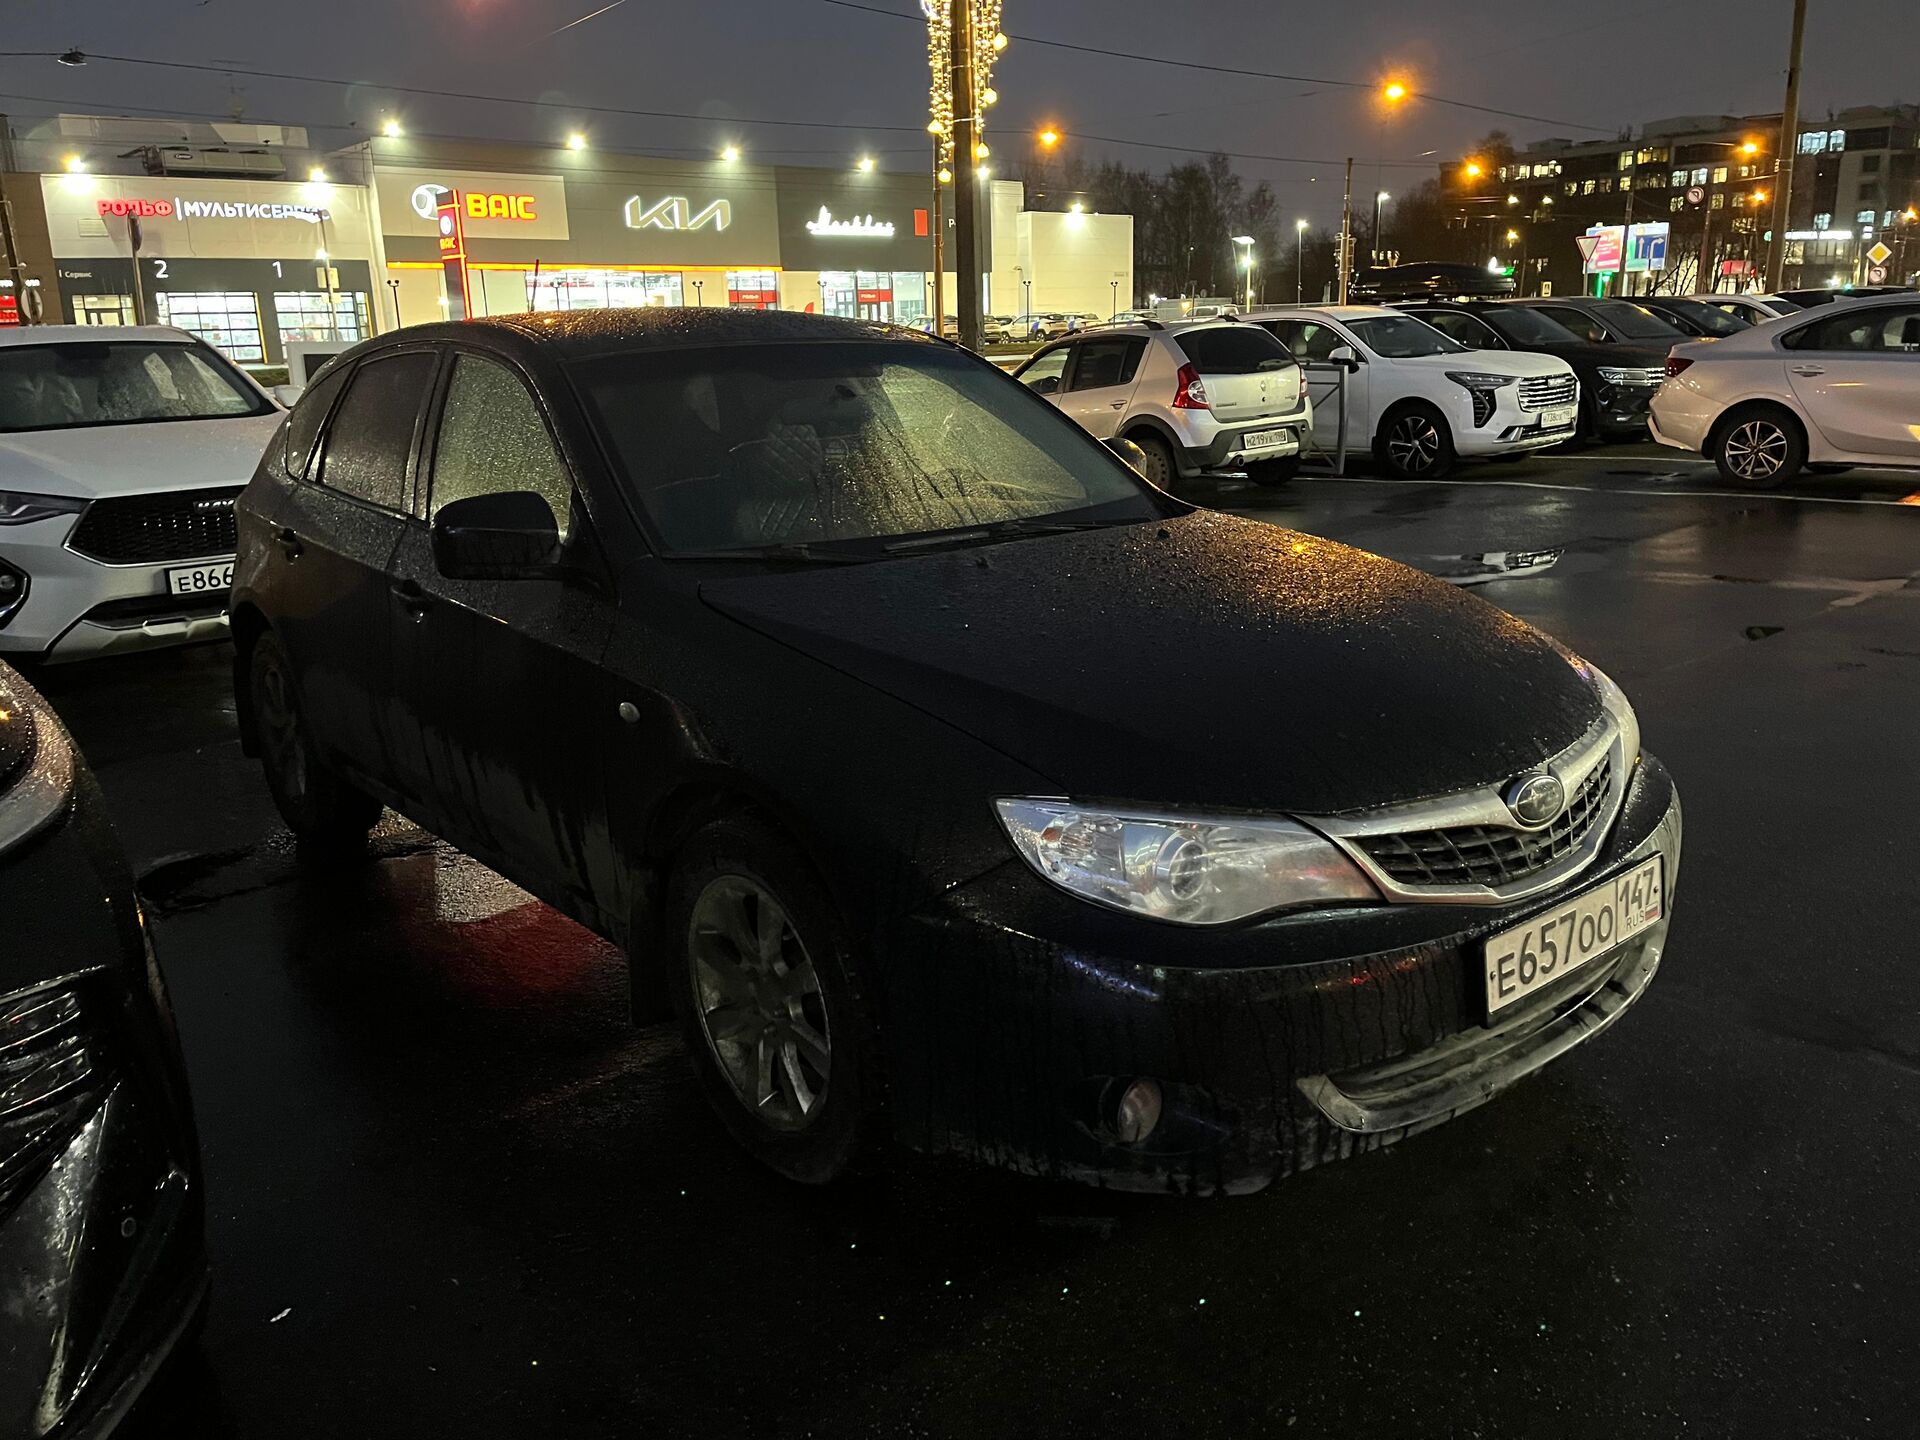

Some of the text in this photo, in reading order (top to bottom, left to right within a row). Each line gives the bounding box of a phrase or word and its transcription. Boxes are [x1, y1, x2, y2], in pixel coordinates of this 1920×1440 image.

[98, 198, 174, 217] РОЛЬФ
[465, 193, 537, 220] BAIC
[440, 237, 456, 250] BAIC
[154, 259, 169, 279] 2
[272, 260, 283, 279] 1
[1619, 866, 1655, 918] 147
[1626, 913, 1646, 931] RUS
